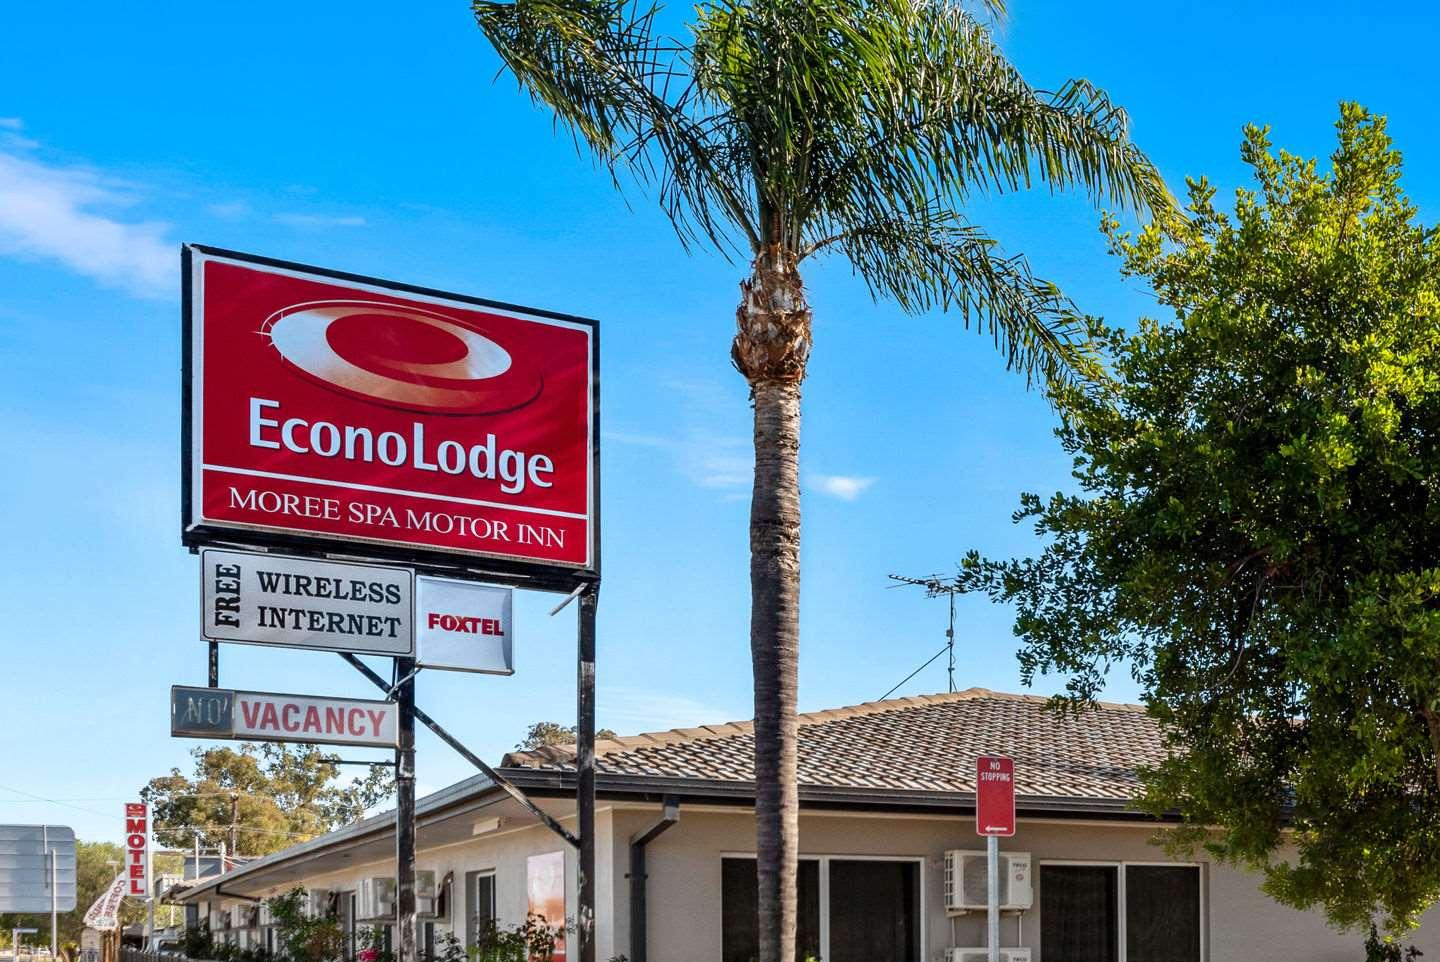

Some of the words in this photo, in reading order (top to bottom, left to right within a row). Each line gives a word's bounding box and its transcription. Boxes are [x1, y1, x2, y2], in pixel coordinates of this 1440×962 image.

[249, 396, 555, 495] EconoLodge
[228, 486, 341, 520] MOREE
[348, 502, 400, 529] SPA
[406, 509, 511, 542] MOTOR
[518, 524, 565, 549] INN
[214, 563, 241, 629] FREE
[256, 570, 402, 605] WIRELESS
[257, 606, 402, 638] INTERNET
[427, 612, 505, 637] FOXTEL
[240, 700, 387, 737] VACANCY
[981, 772, 1011, 782] STOPPING
[990, 761, 1001, 771] NO
[126, 819, 146, 895] MOTEL
